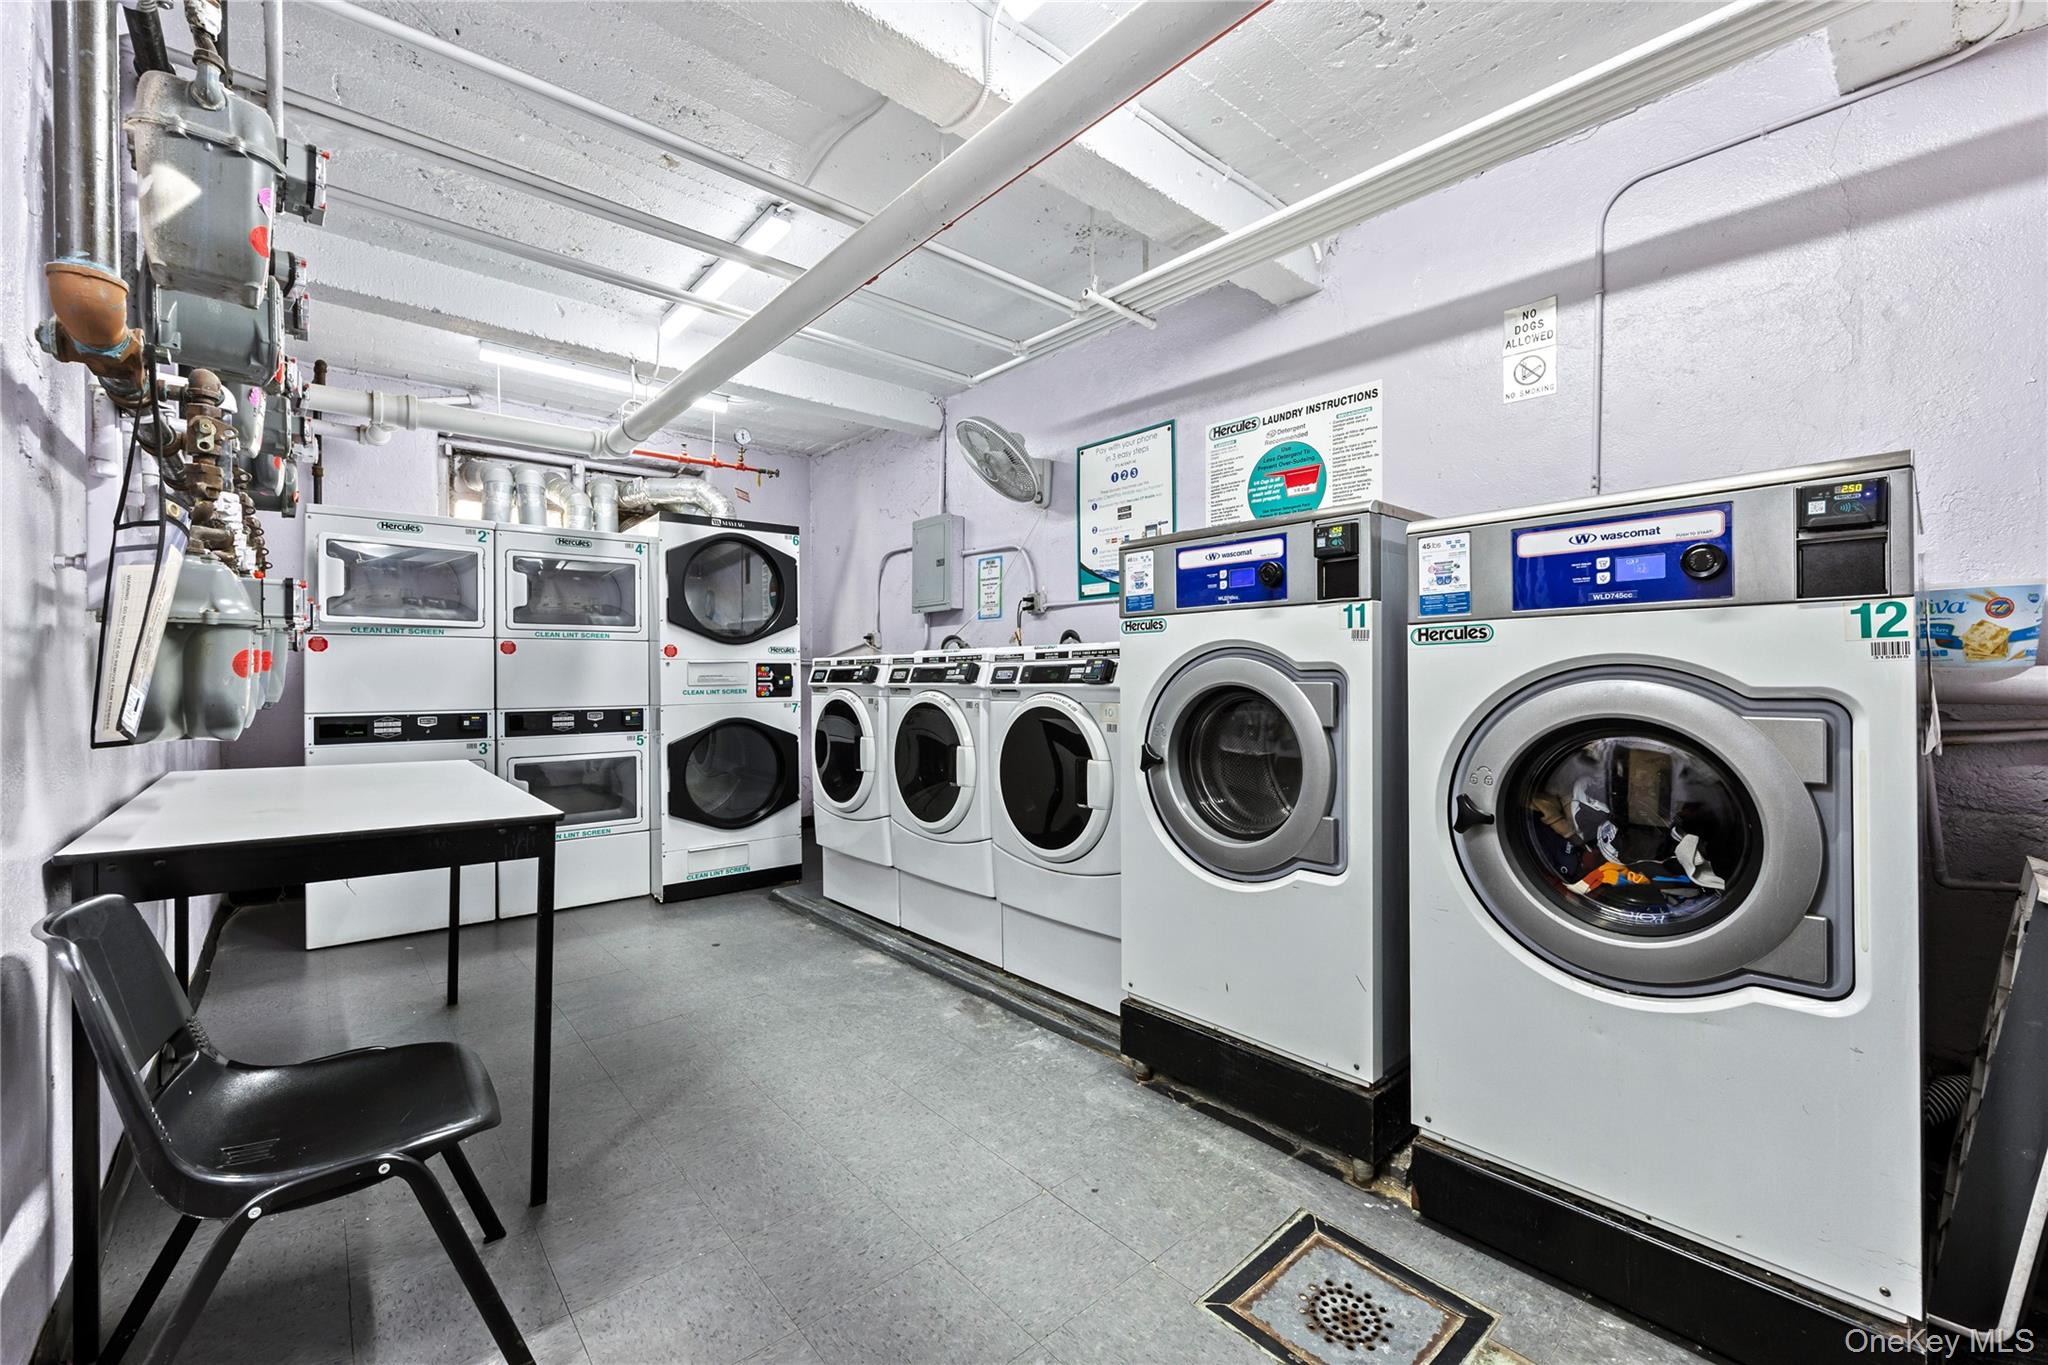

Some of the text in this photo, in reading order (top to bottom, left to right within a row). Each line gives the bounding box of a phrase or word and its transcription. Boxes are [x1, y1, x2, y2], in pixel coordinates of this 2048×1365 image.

[1522, 308, 1536, 320] NO
[1514, 319, 1544, 335] DOGS
[1504, 329, 1554, 350] ALLOWED
[1505, 384, 1555, 400] NO SMOKING
[1212, 418, 1258, 438] Hercules
[1262, 408, 1304, 426] LAUNDRY
[1306, 388, 1378, 414] INSTRUCTIONS
[1277, 424, 1306, 435] Detergent
[1096, 433, 1158, 456] Pay with your phone
[1264, 431, 1308, 446] Recommended
[1117, 450, 1132, 460] easy
[1132, 446, 1150, 456] steps
[1277, 450, 1303, 461] Detergent
[381, 522, 420, 532] Hercules
[478, 530, 487, 543] 2
[1600, 526, 1661, 542] wascomat
[558, 538, 590, 548] Hercules
[792, 536, 800, 546] 6
[635, 544, 643, 555] 4
[1222, 548, 1252, 558] wascomat
[1343, 603, 1366, 628] 11
[1850, 601, 1908, 638] 12
[1125, 619, 1164, 631] Hercules
[1417, 626, 1488, 642] Hercules
[792, 702, 799, 713] 7
[636, 734, 644, 746] 5
[479, 742, 488, 755] 3
[582, 828, 611, 837] SCREEN
[687, 872, 708, 880] CLEAN
[725, 866, 750, 875] SCREEN
